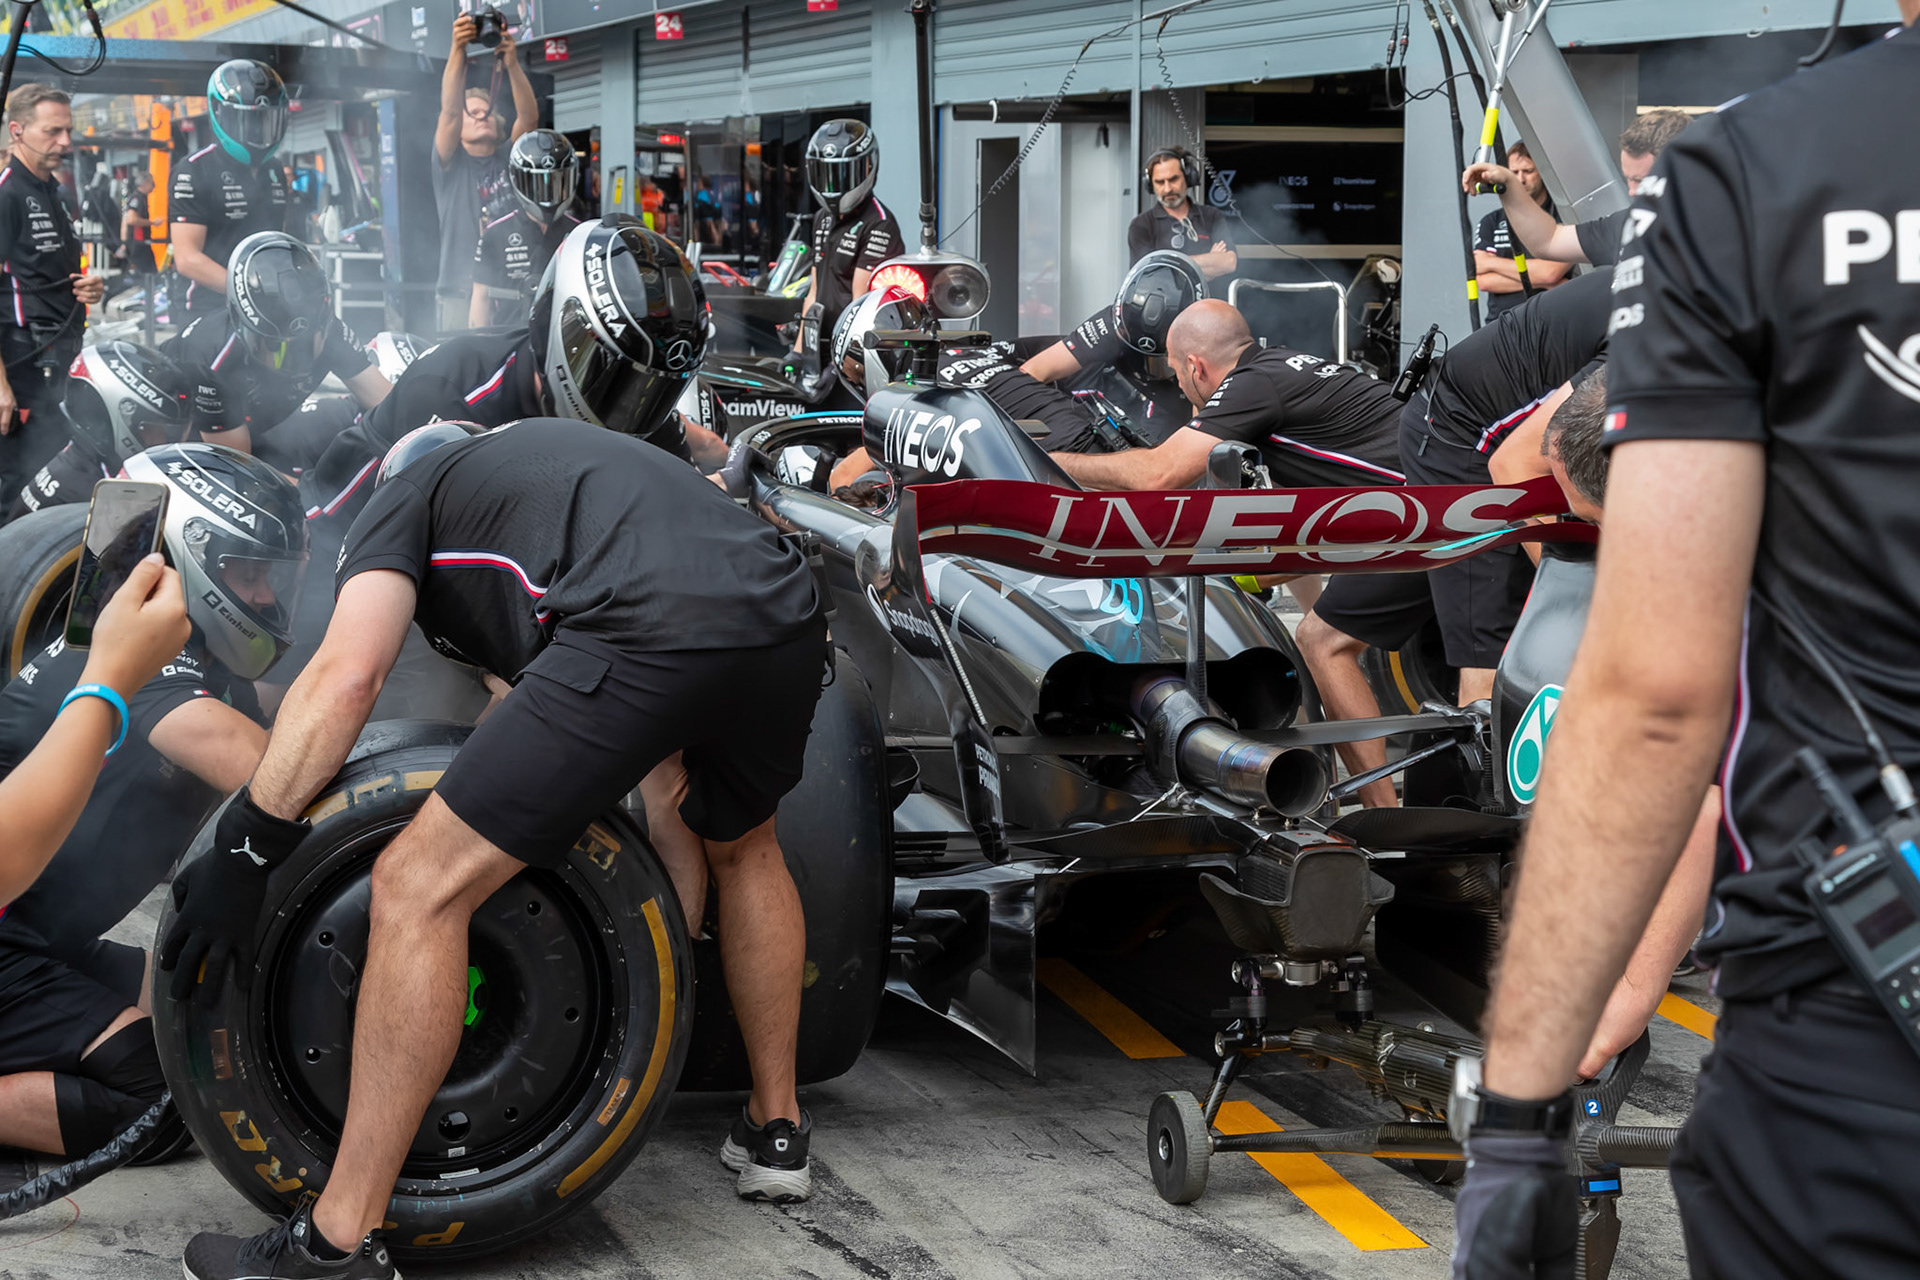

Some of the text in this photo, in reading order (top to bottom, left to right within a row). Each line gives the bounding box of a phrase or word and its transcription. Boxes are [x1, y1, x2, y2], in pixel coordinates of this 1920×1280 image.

[656, 14, 682, 32] 24
[545, 40, 568, 54] 25
[235, 273, 259, 326] SOLERA
[585, 256, 627, 339] SOLERA
[1095, 318, 1109, 336] IWC
[115, 365, 163, 408] SOLERA
[198, 385, 217, 396] IWC
[700, 402, 712, 431] SOLE
[883, 407, 982, 478] INEOS
[177, 469, 256, 530] SOLERA
[1028, 487, 1528, 567] INEOS
[217, 606, 258, 640] Einhell
[1587, 1101, 1599, 1114] 2
